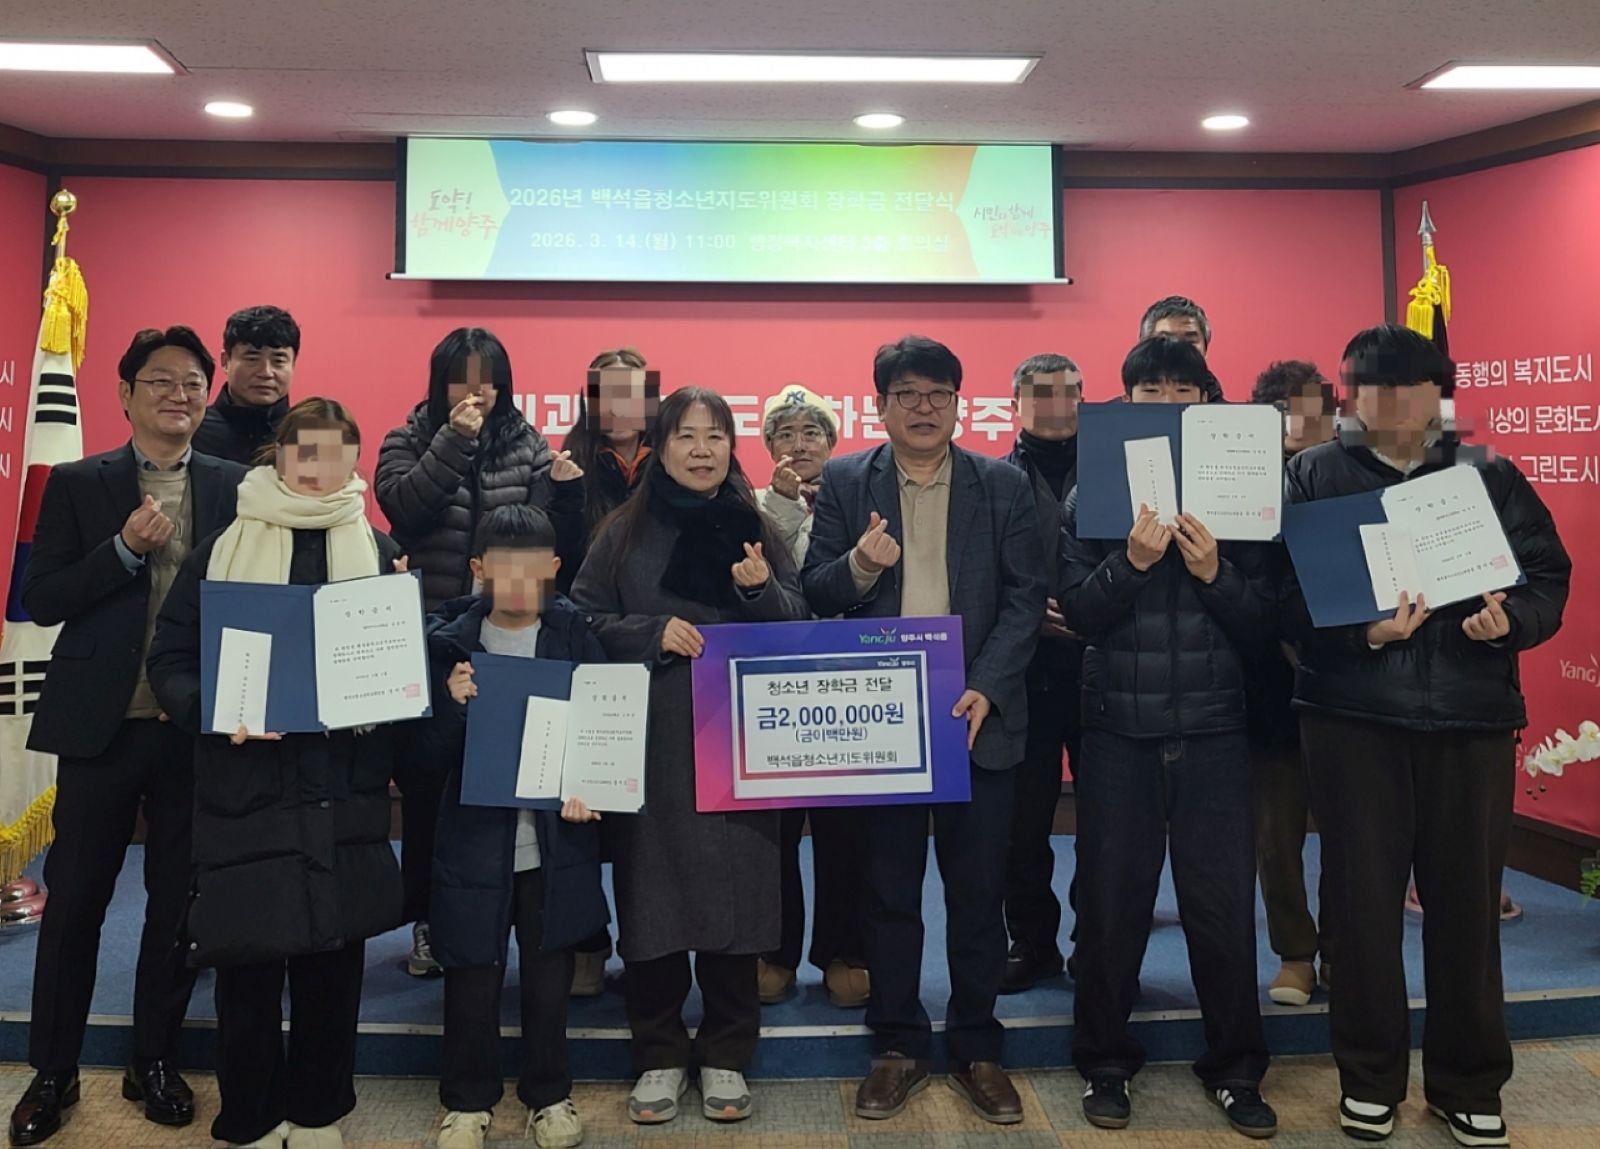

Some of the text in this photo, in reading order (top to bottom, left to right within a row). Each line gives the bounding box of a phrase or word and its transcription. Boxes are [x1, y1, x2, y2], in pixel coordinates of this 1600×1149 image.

[510, 188, 954, 211] 2026년 백석읍청소년지도위원회 장학금 전달식
[530, 232, 583, 249] 2026.
[590, 233, 607, 249] 3.
[686, 234, 736, 250] 11:00
[1455, 353, 1592, 388] 동행의 복지도시
[1488, 406, 1530, 434] 상의
[1520, 455, 1599, 484] 그린도시
[768, 676, 893, 696] 청소년 장학금 전달
[757, 702, 905, 731] 금2,000,000원
[795, 727, 868, 743] (금이백만원)
[767, 750, 898, 768] 백석읍청소년지도위원회
